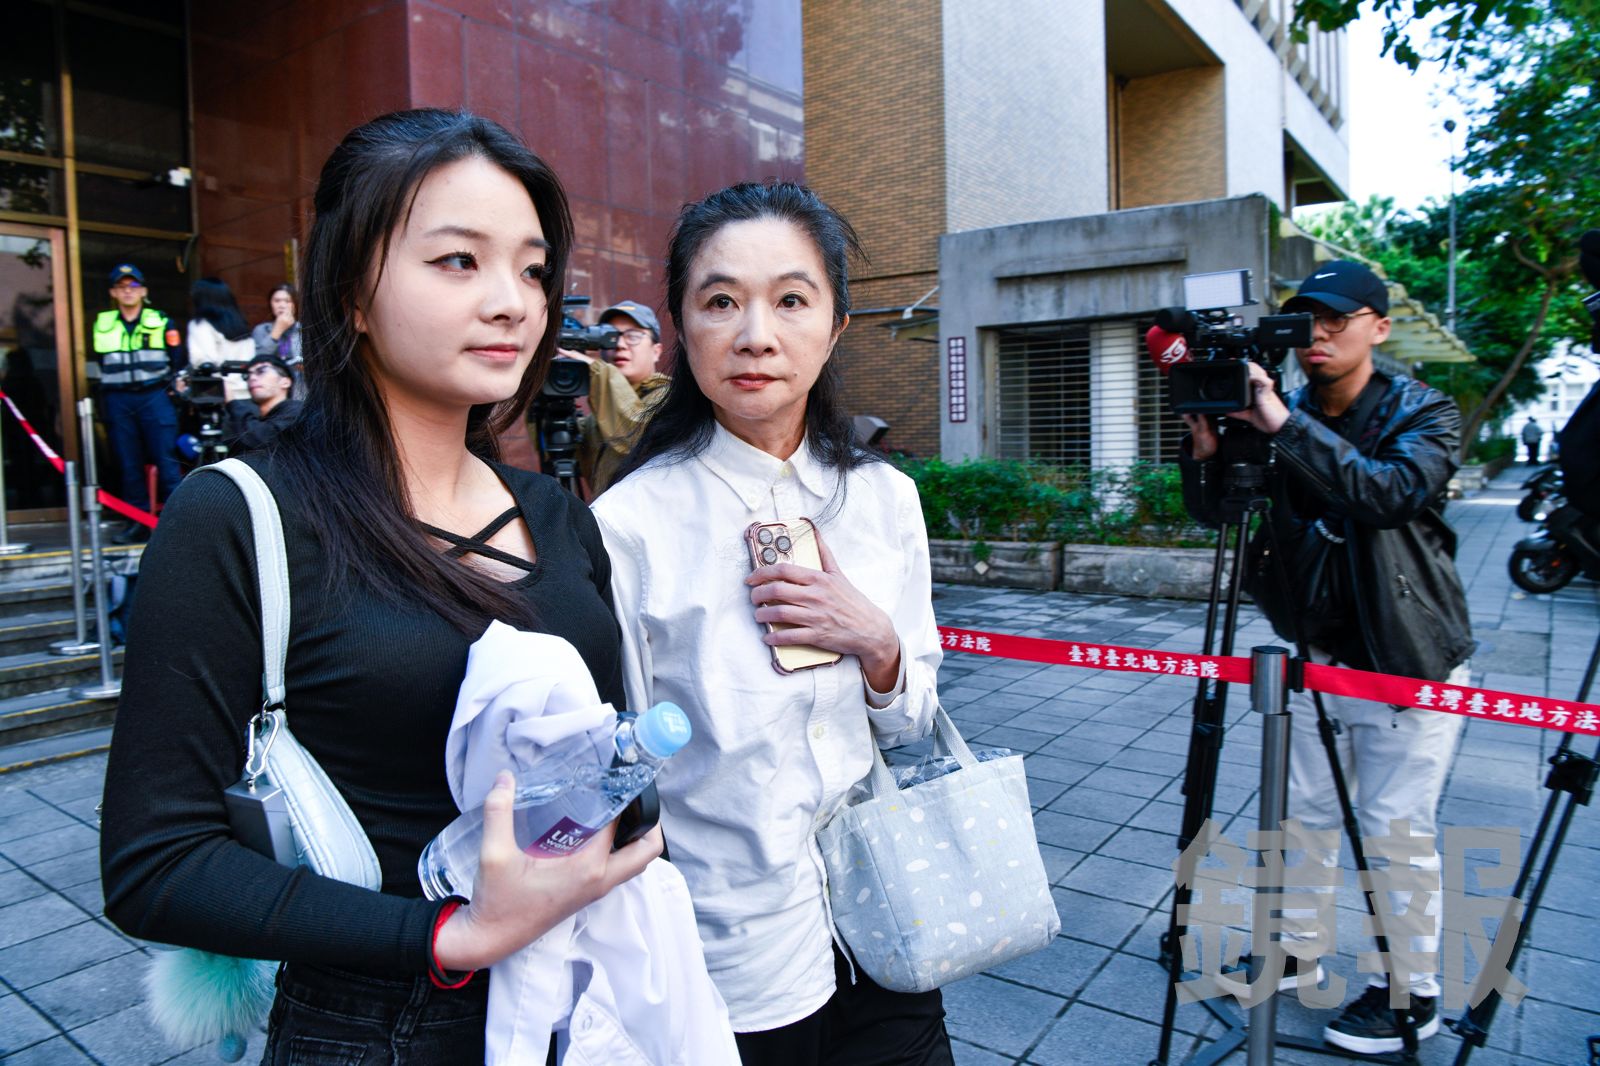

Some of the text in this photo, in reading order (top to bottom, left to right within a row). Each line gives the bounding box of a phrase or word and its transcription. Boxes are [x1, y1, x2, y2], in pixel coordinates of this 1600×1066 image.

[1068, 645, 1221, 679] 臺灣臺北地方法院
